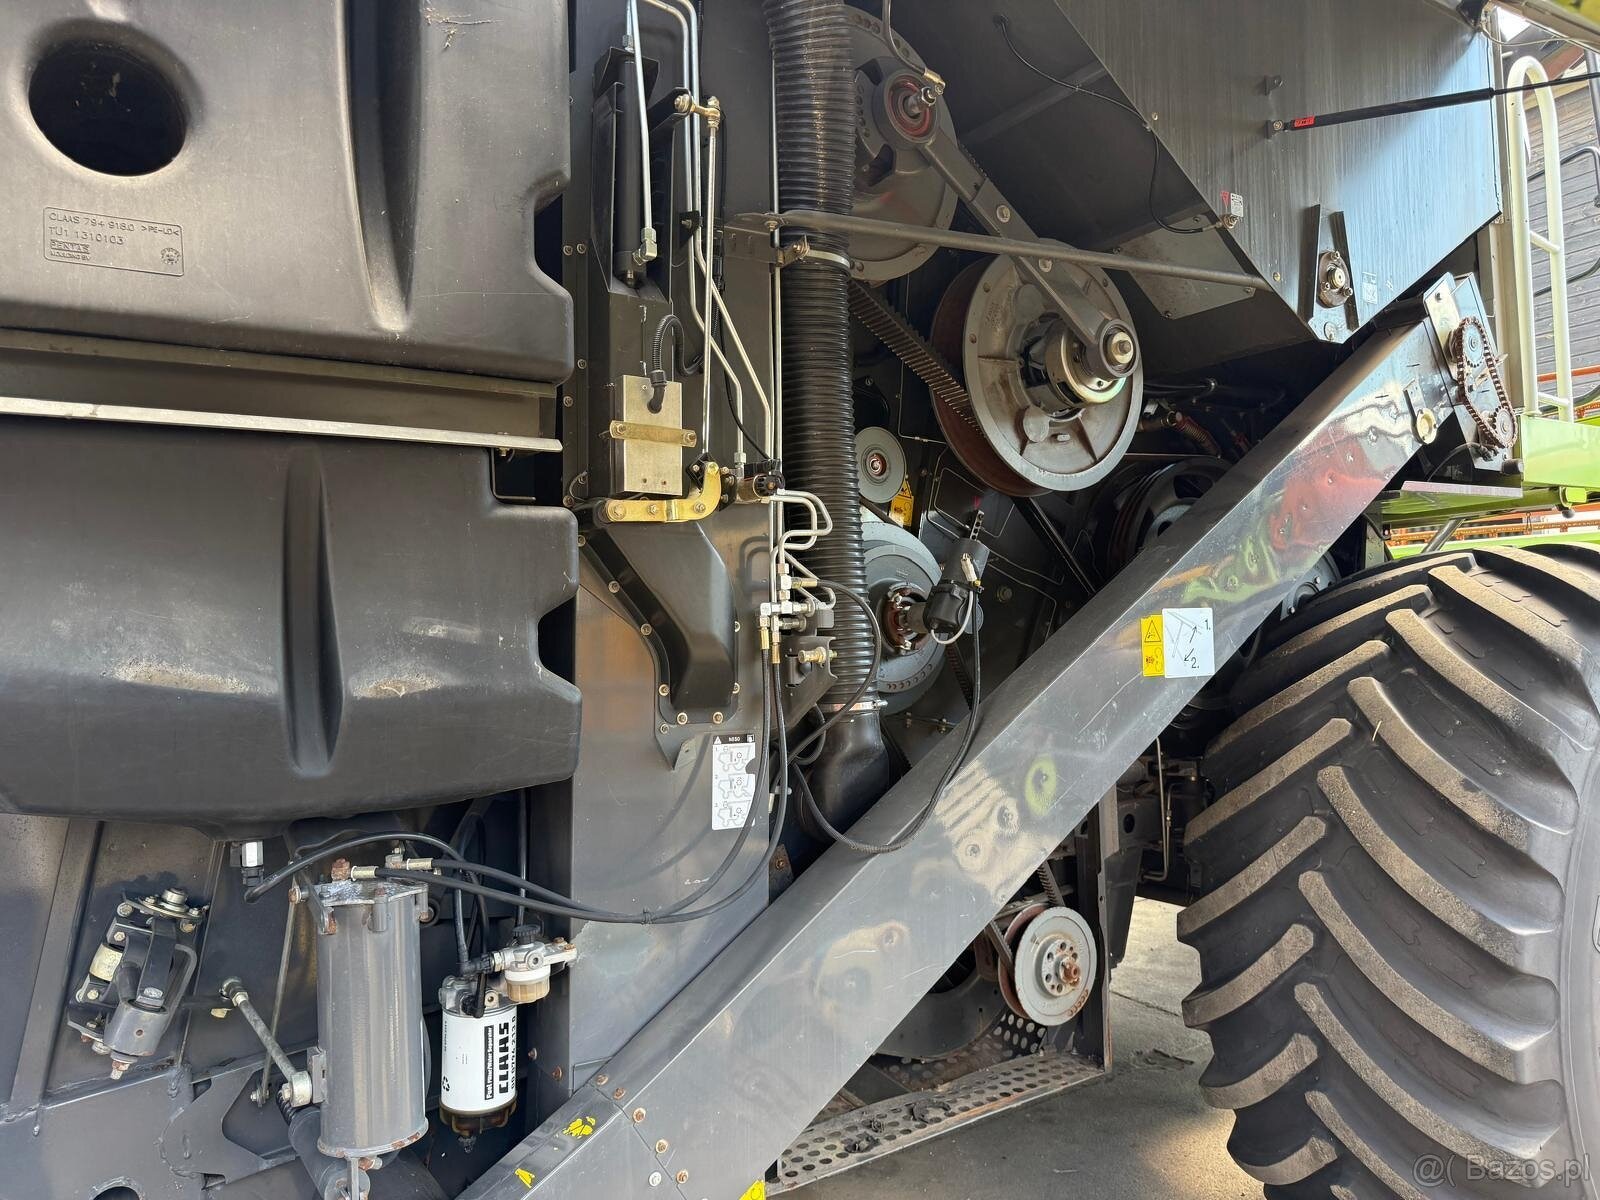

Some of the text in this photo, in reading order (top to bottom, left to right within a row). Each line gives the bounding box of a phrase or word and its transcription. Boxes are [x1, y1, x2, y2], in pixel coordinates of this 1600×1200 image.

[49, 212, 80, 224] CLAAS
[83, 217, 105, 228] 794
[1205, 619, 1211, 631] 1.
[1191, 657, 1200, 669] 2.
[499, 1022, 509, 1094] CLAAS
